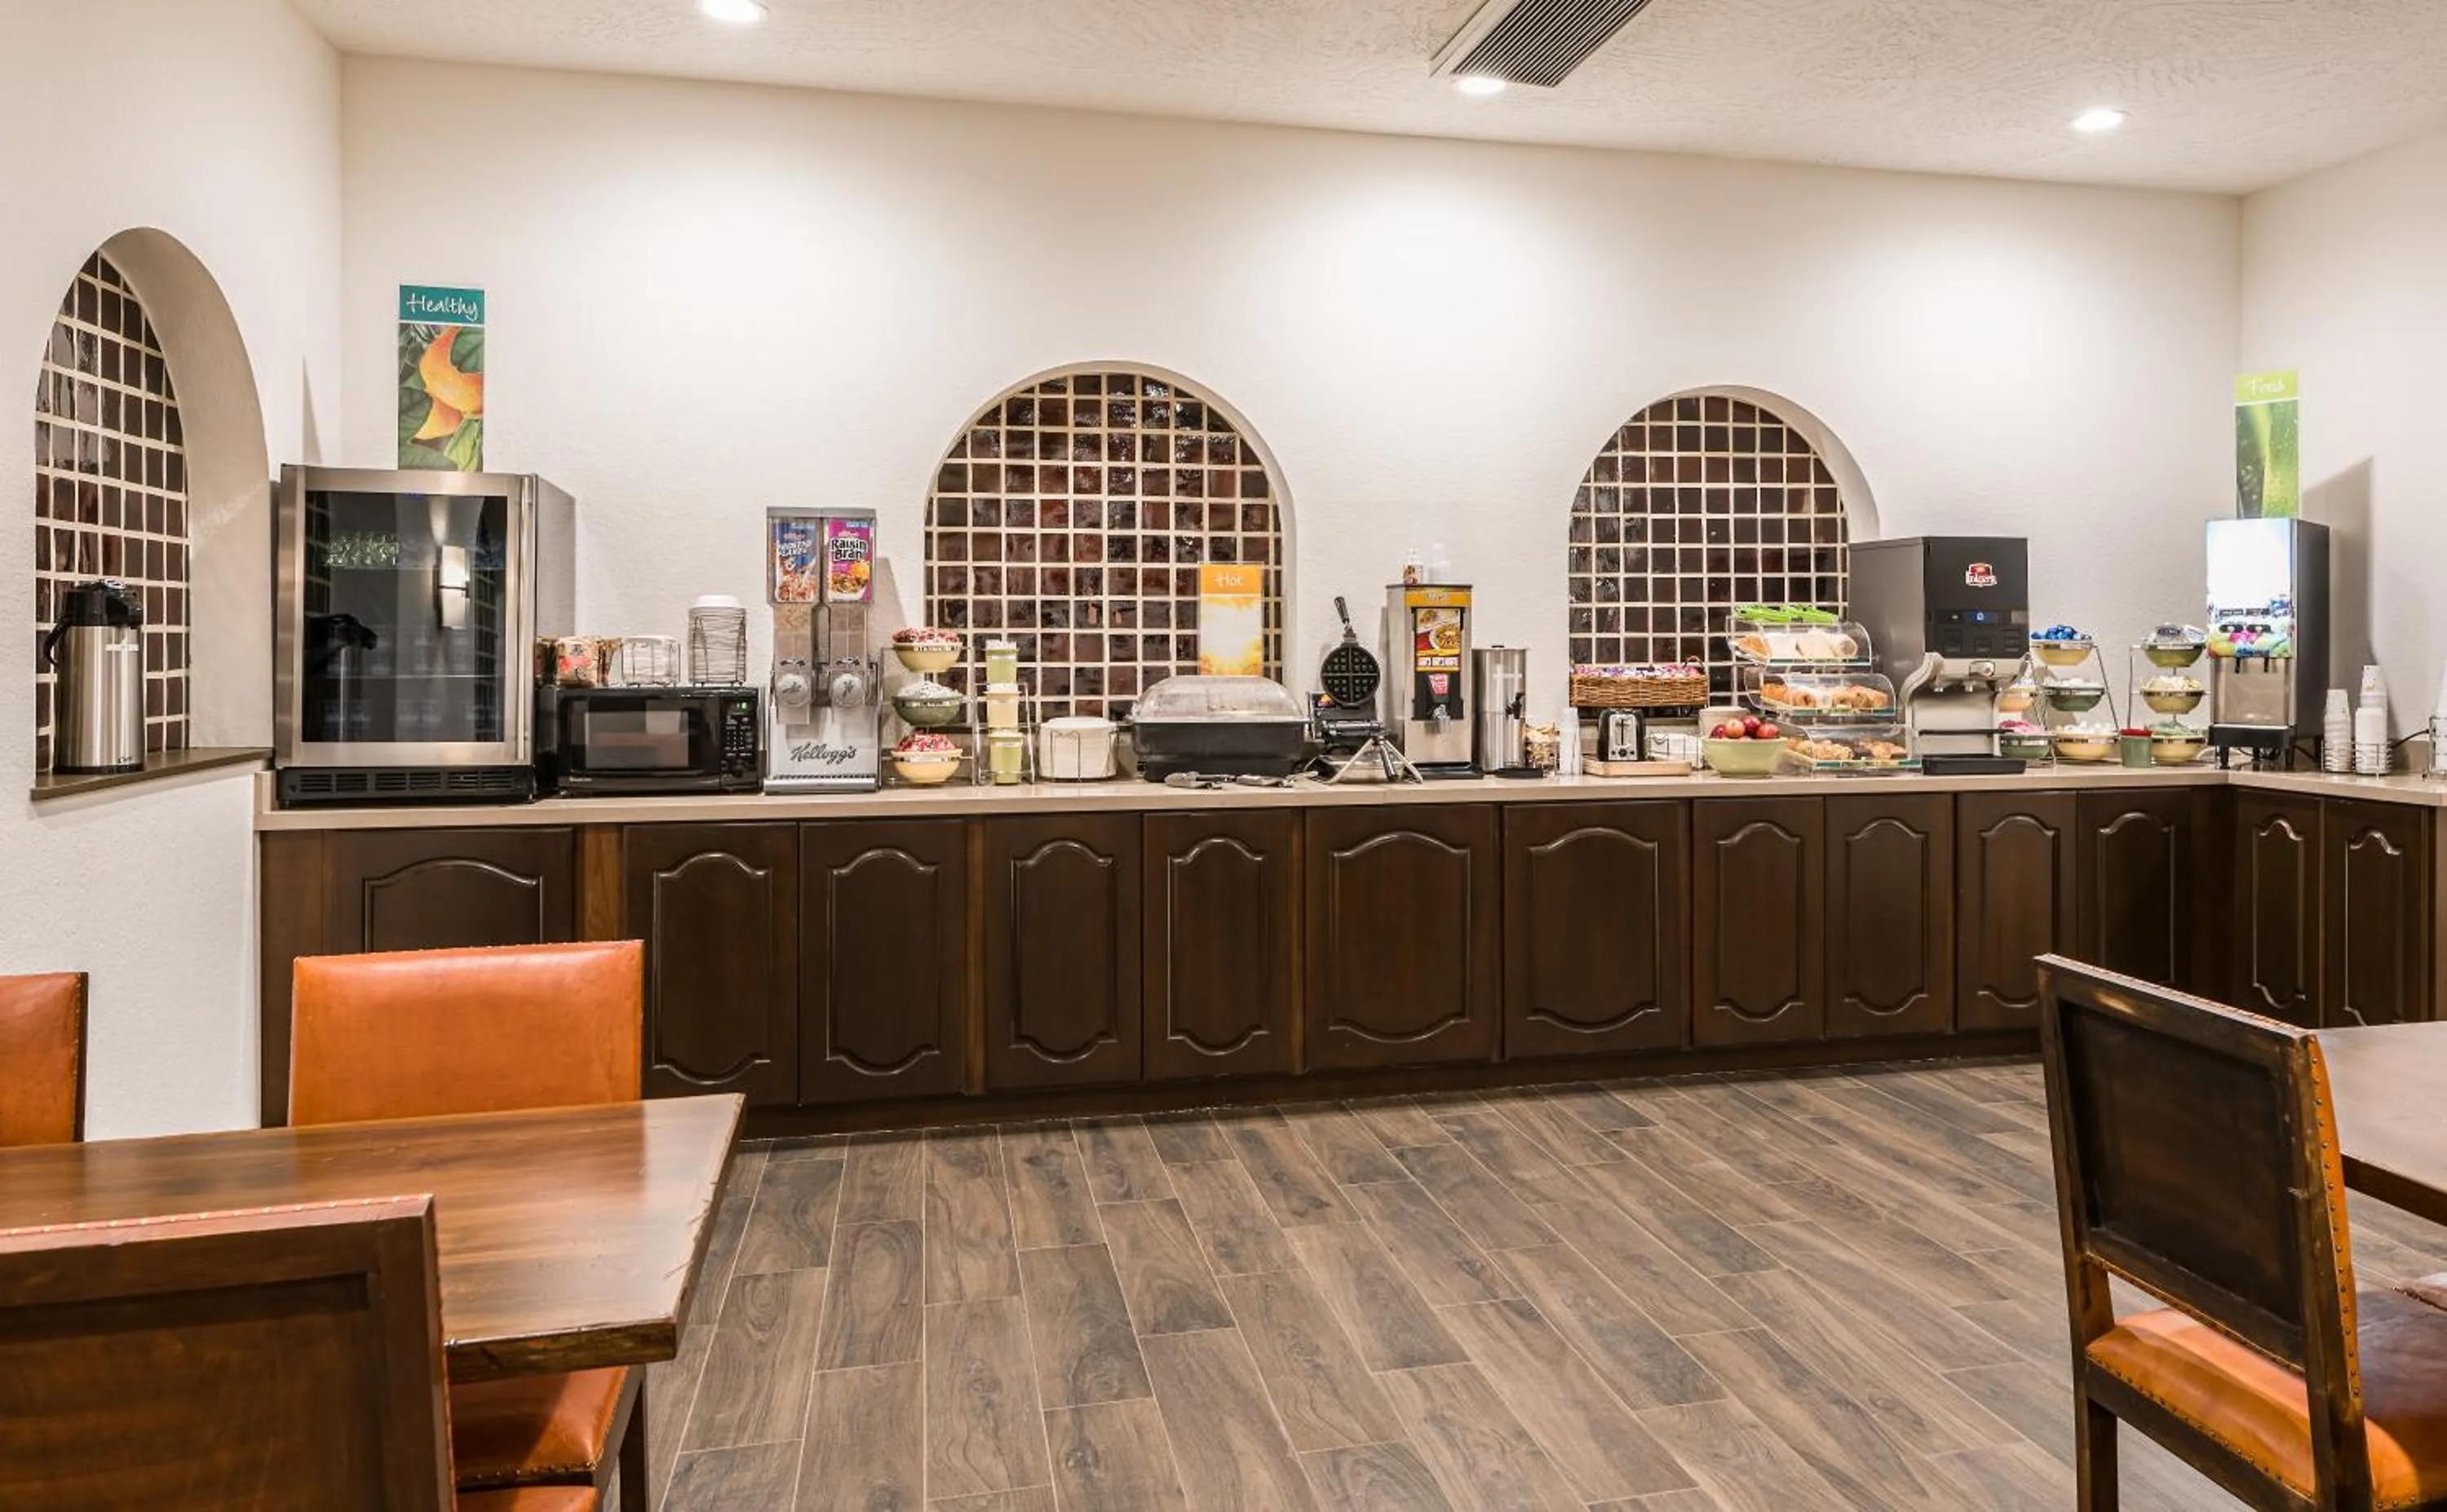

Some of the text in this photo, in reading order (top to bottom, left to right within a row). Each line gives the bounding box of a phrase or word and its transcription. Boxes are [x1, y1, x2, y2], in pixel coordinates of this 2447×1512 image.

[406, 293, 478, 322] Healthy
[831, 538, 868, 550] Raisin
[834, 549, 862, 560] Bran
[1214, 573, 1245, 588] Hot
[790, 741, 857, 765] Kellogg's
